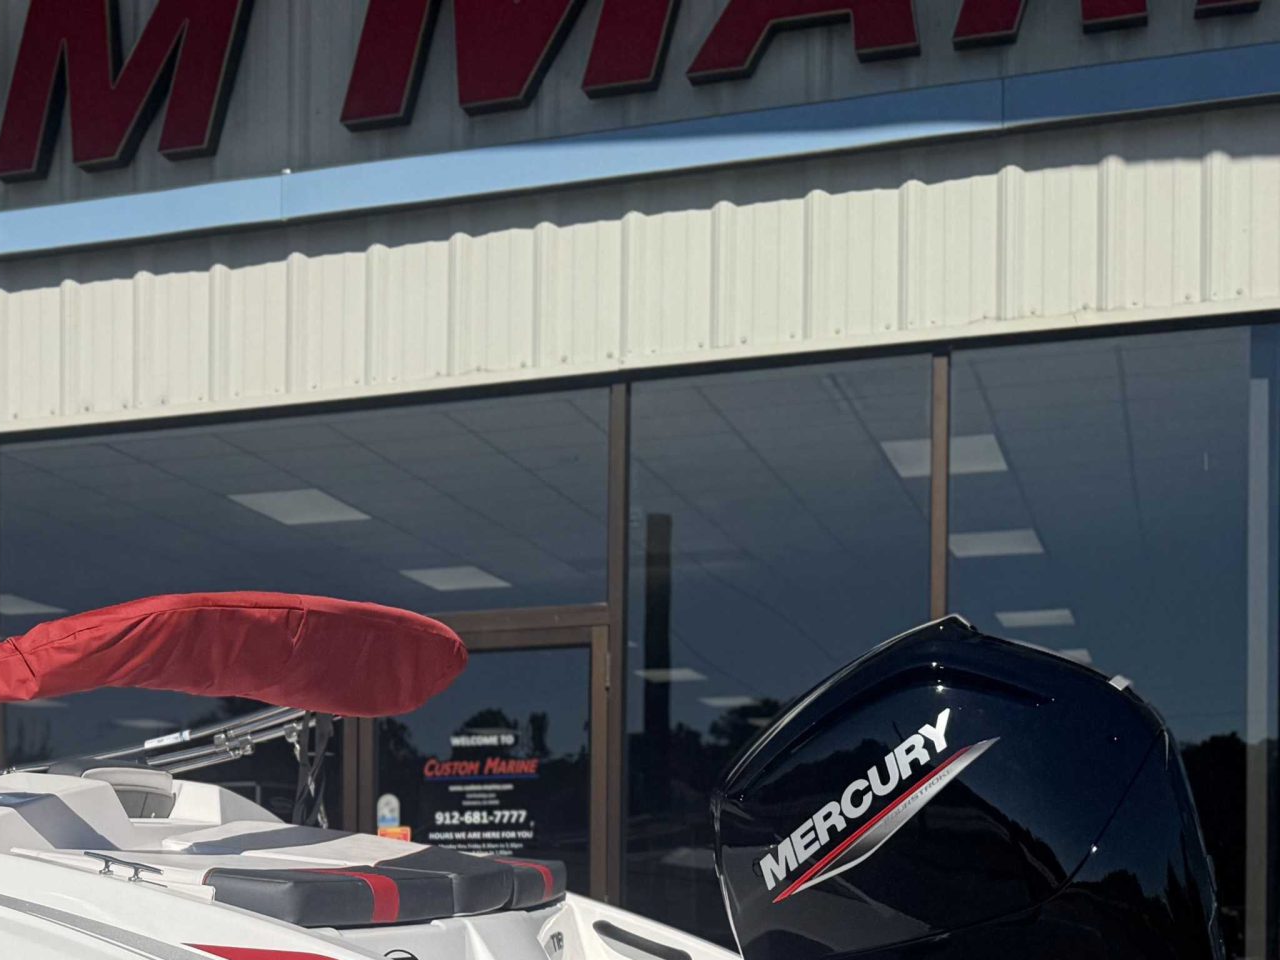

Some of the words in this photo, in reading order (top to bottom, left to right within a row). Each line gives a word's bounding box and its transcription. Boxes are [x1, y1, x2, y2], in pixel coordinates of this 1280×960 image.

[450, 735, 498, 746] WELCOME
[500, 734, 515, 745] TO
[424, 757, 480, 776] CUSTOM
[483, 757, 539, 775] MARINE
[758, 707, 951, 891] MERCURY
[435, 810, 527, 825] 912-681-7777
[429, 832, 453, 840] HOURS
[455, 832, 466, 840] WE
[482, 831, 500, 839] HERE
[501, 831, 516, 839] FOR
[517, 830, 533, 839] YOU
